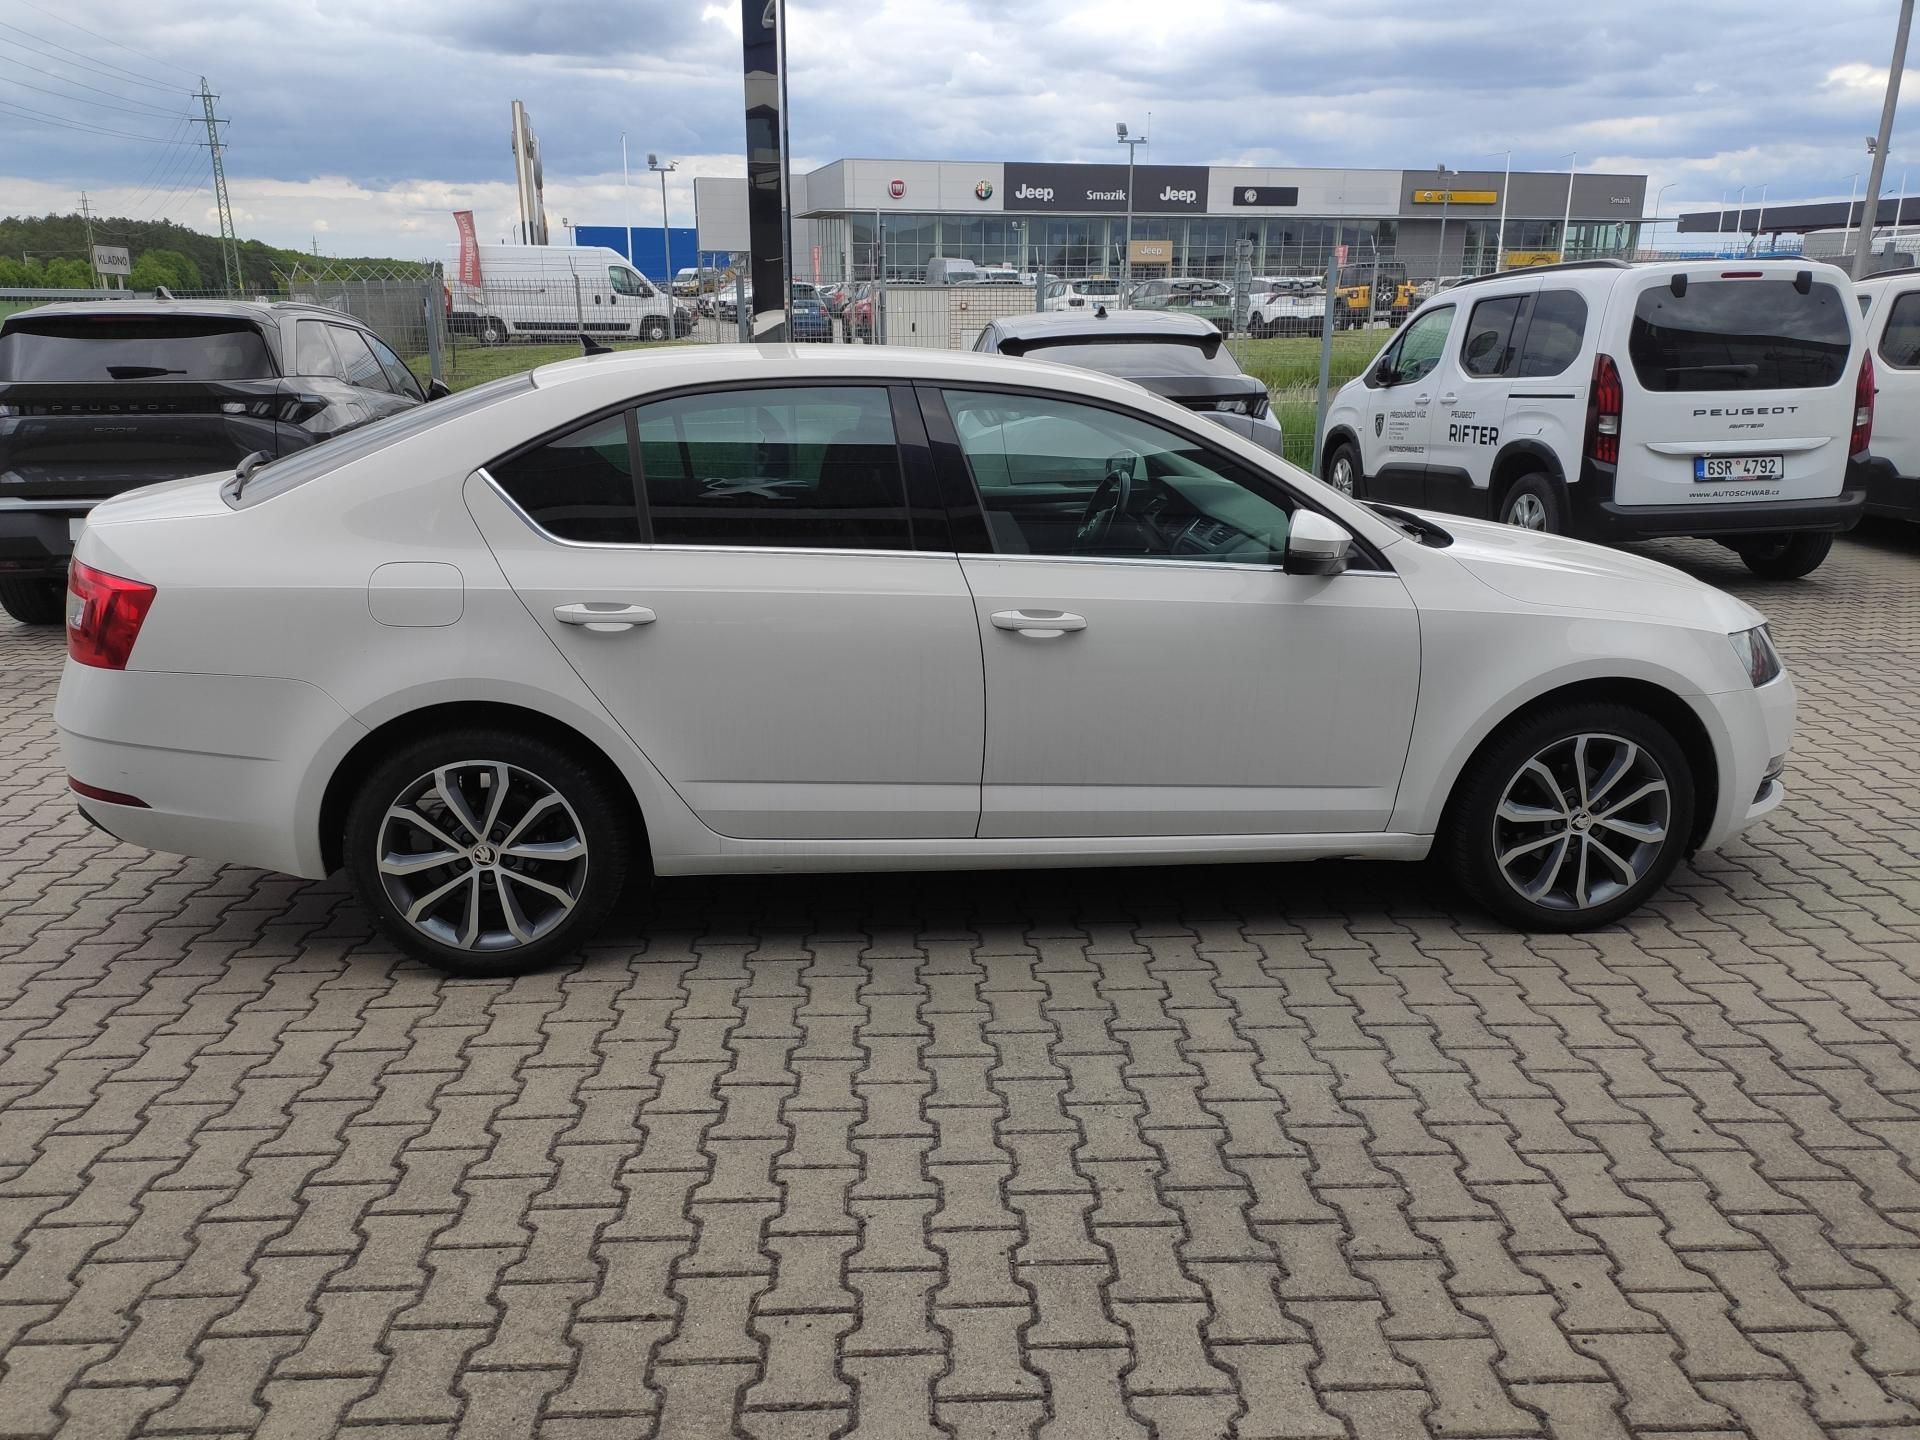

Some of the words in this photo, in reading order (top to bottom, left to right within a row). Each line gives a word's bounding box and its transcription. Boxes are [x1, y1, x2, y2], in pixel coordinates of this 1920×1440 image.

[1015, 183, 1054, 202] Jeep
[1160, 186, 1197, 203] Jeep
[1141, 245, 1162, 256] Jeep
[97, 254, 128, 266] KLADNO
[1450, 410, 1476, 419] PEUGEOT
[1693, 406, 1799, 416] PEUGEOT
[1448, 424, 1499, 446] RIFTER
[1707, 461, 1732, 475] 6SR
[1743, 459, 1776, 474] 4792
[1689, 489, 1780, 498] www.AUTOSCHWAB.cz
